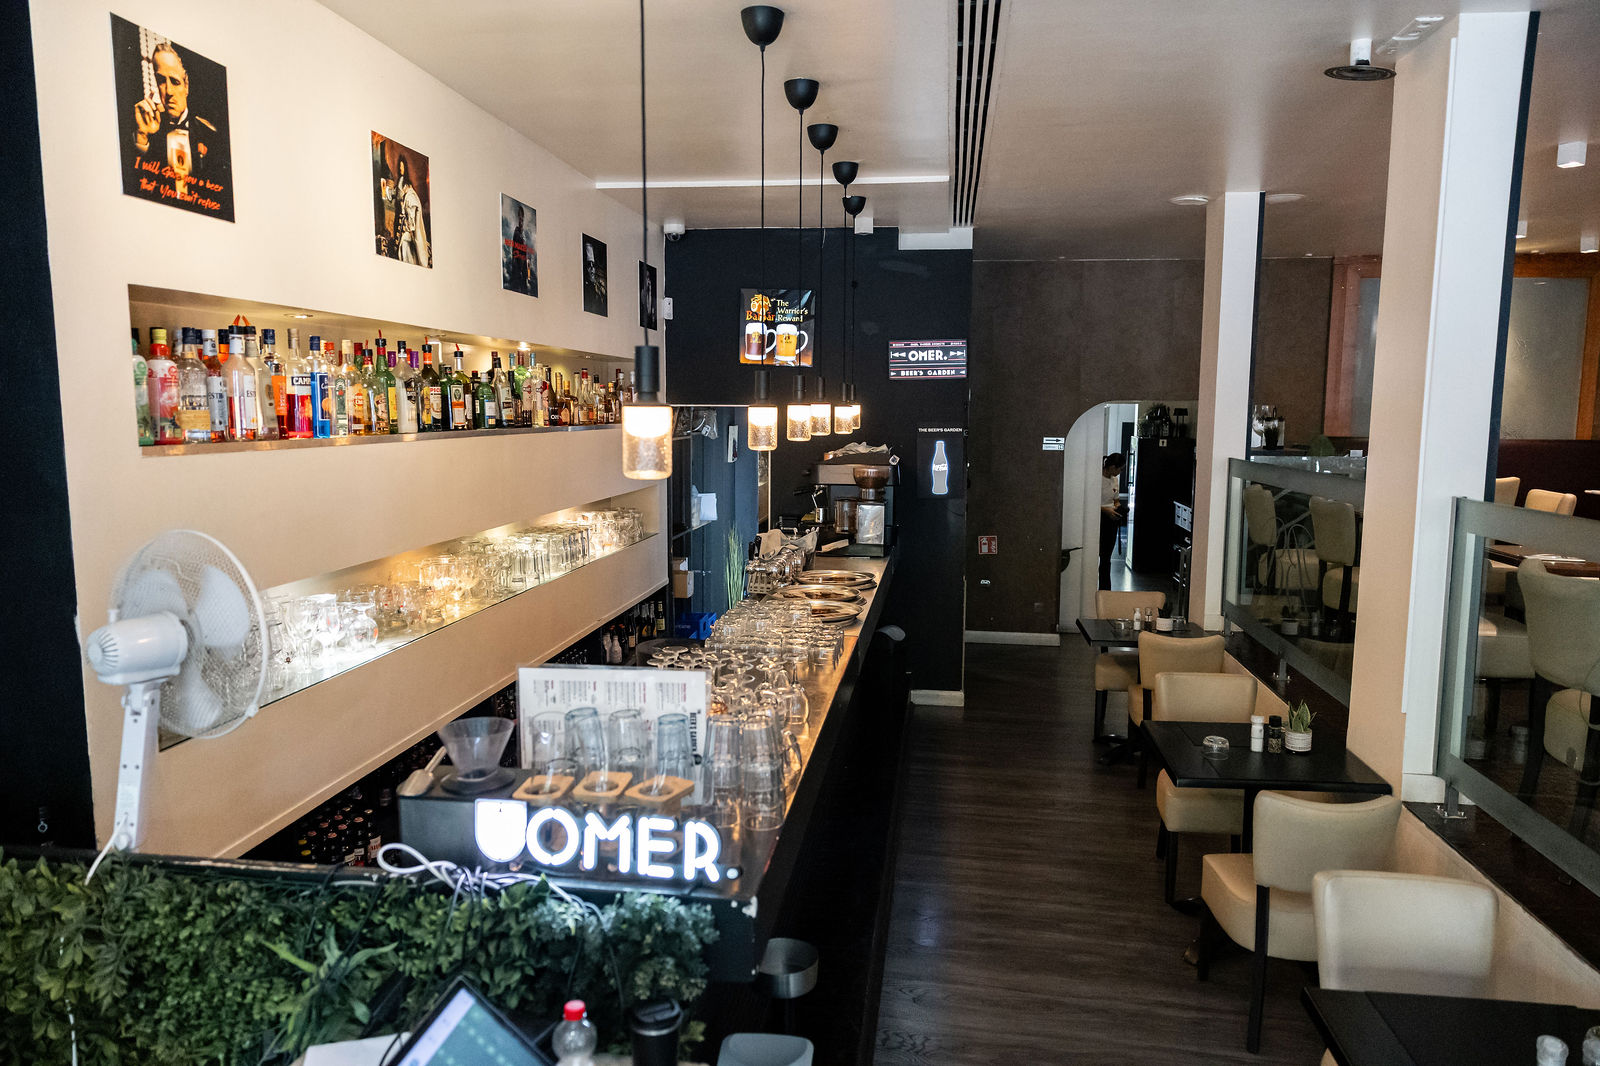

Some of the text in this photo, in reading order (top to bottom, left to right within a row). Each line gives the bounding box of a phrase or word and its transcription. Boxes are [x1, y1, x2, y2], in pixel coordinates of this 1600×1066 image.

[134, 156, 141, 169] I
[142, 161, 160, 175] will
[206, 179, 223, 192] beer
[139, 177, 158, 191] that
[198, 198, 221, 210] refuse
[777, 299, 789, 307] The
[908, 349, 948, 361] OMER.
[525, 806, 741, 883] OMER.
